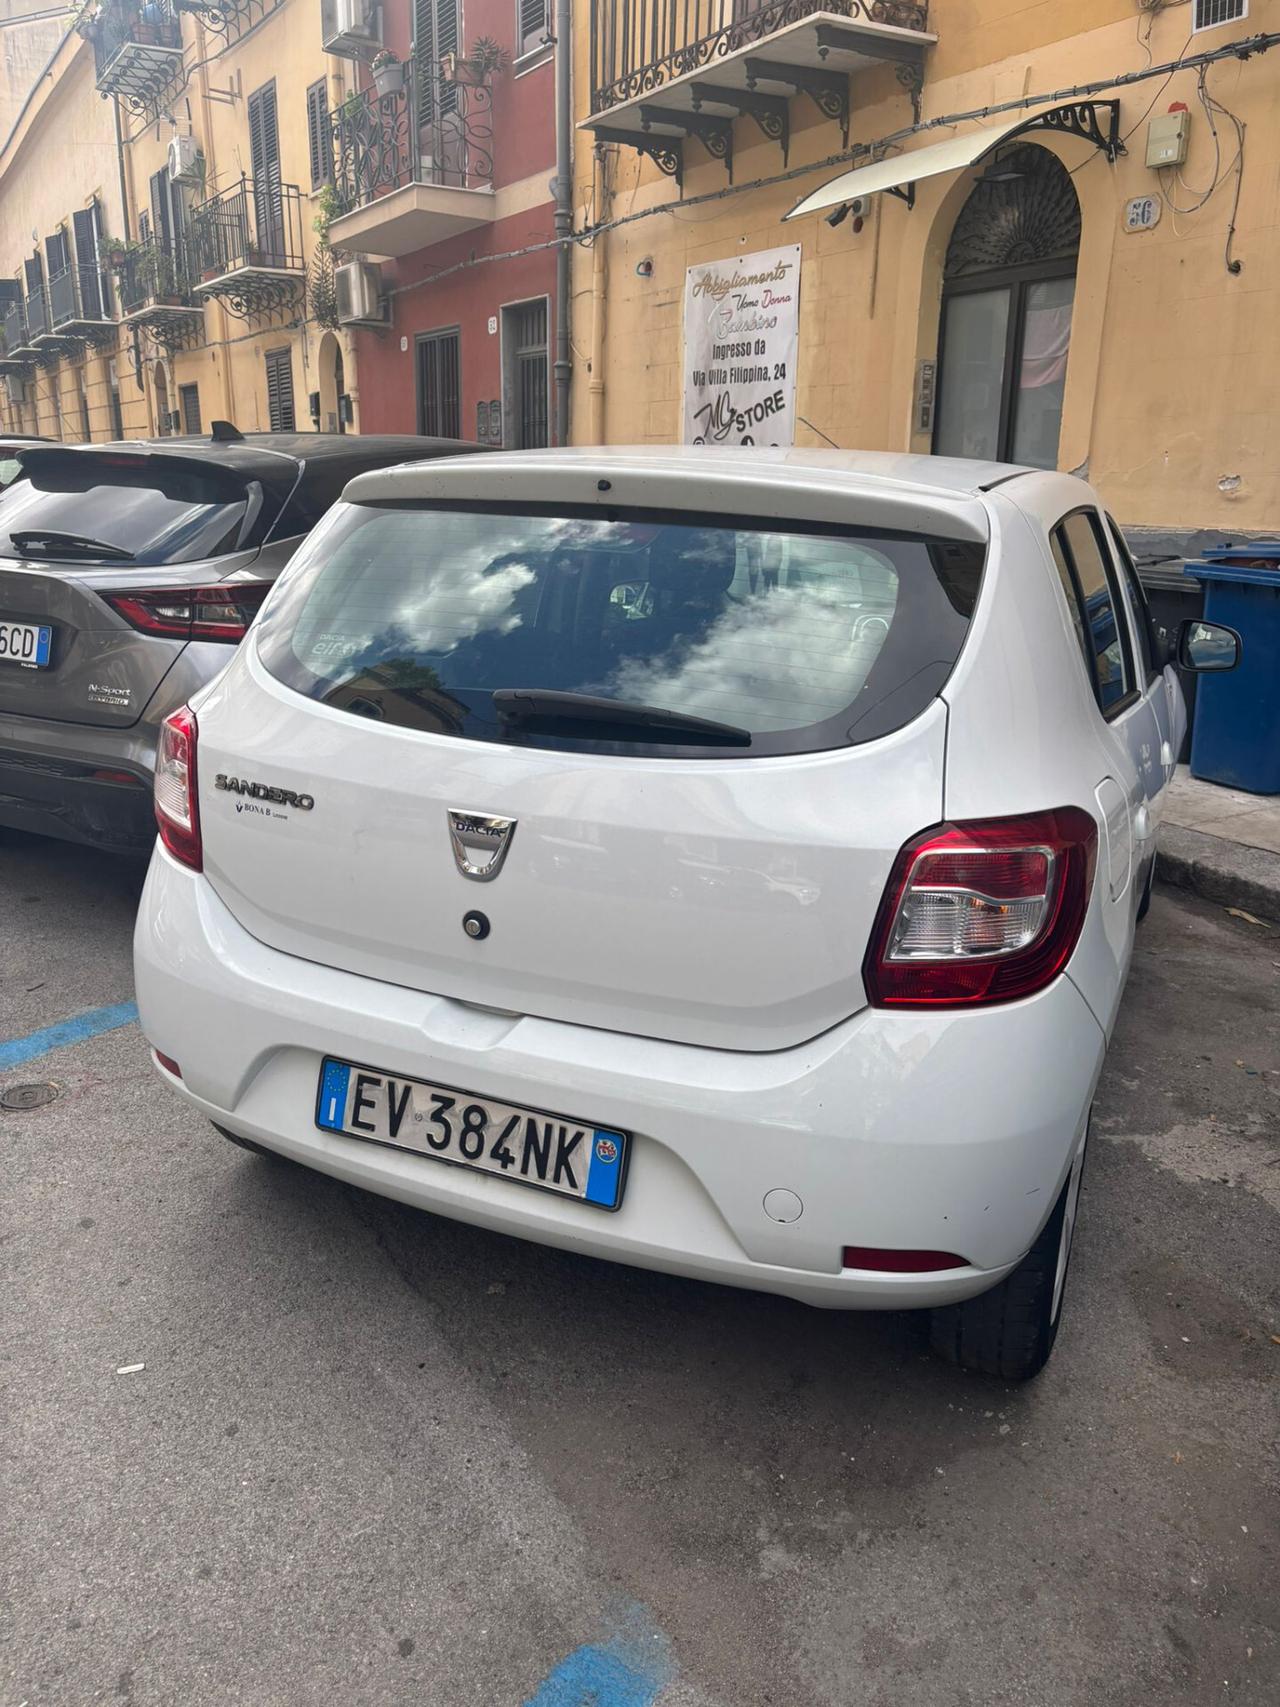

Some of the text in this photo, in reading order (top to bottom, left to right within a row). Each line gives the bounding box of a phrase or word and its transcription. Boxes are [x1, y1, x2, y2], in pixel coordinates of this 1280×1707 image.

[1129, 200, 1153, 226] 56
[693, 260, 793, 302] Abbigliamento
[732, 289, 792, 311] Uomo Donna
[712, 338, 766, 361] Ingresso da
[693, 362, 787, 387] Via Villa Filippina, 24
[735, 389, 786, 433] STORE
[88, 683, 131, 696] N-Sport
[214, 773, 315, 811] SANDERO
[456, 821, 501, 838] DACIA
[351, 1073, 585, 1190] EV 384NK
